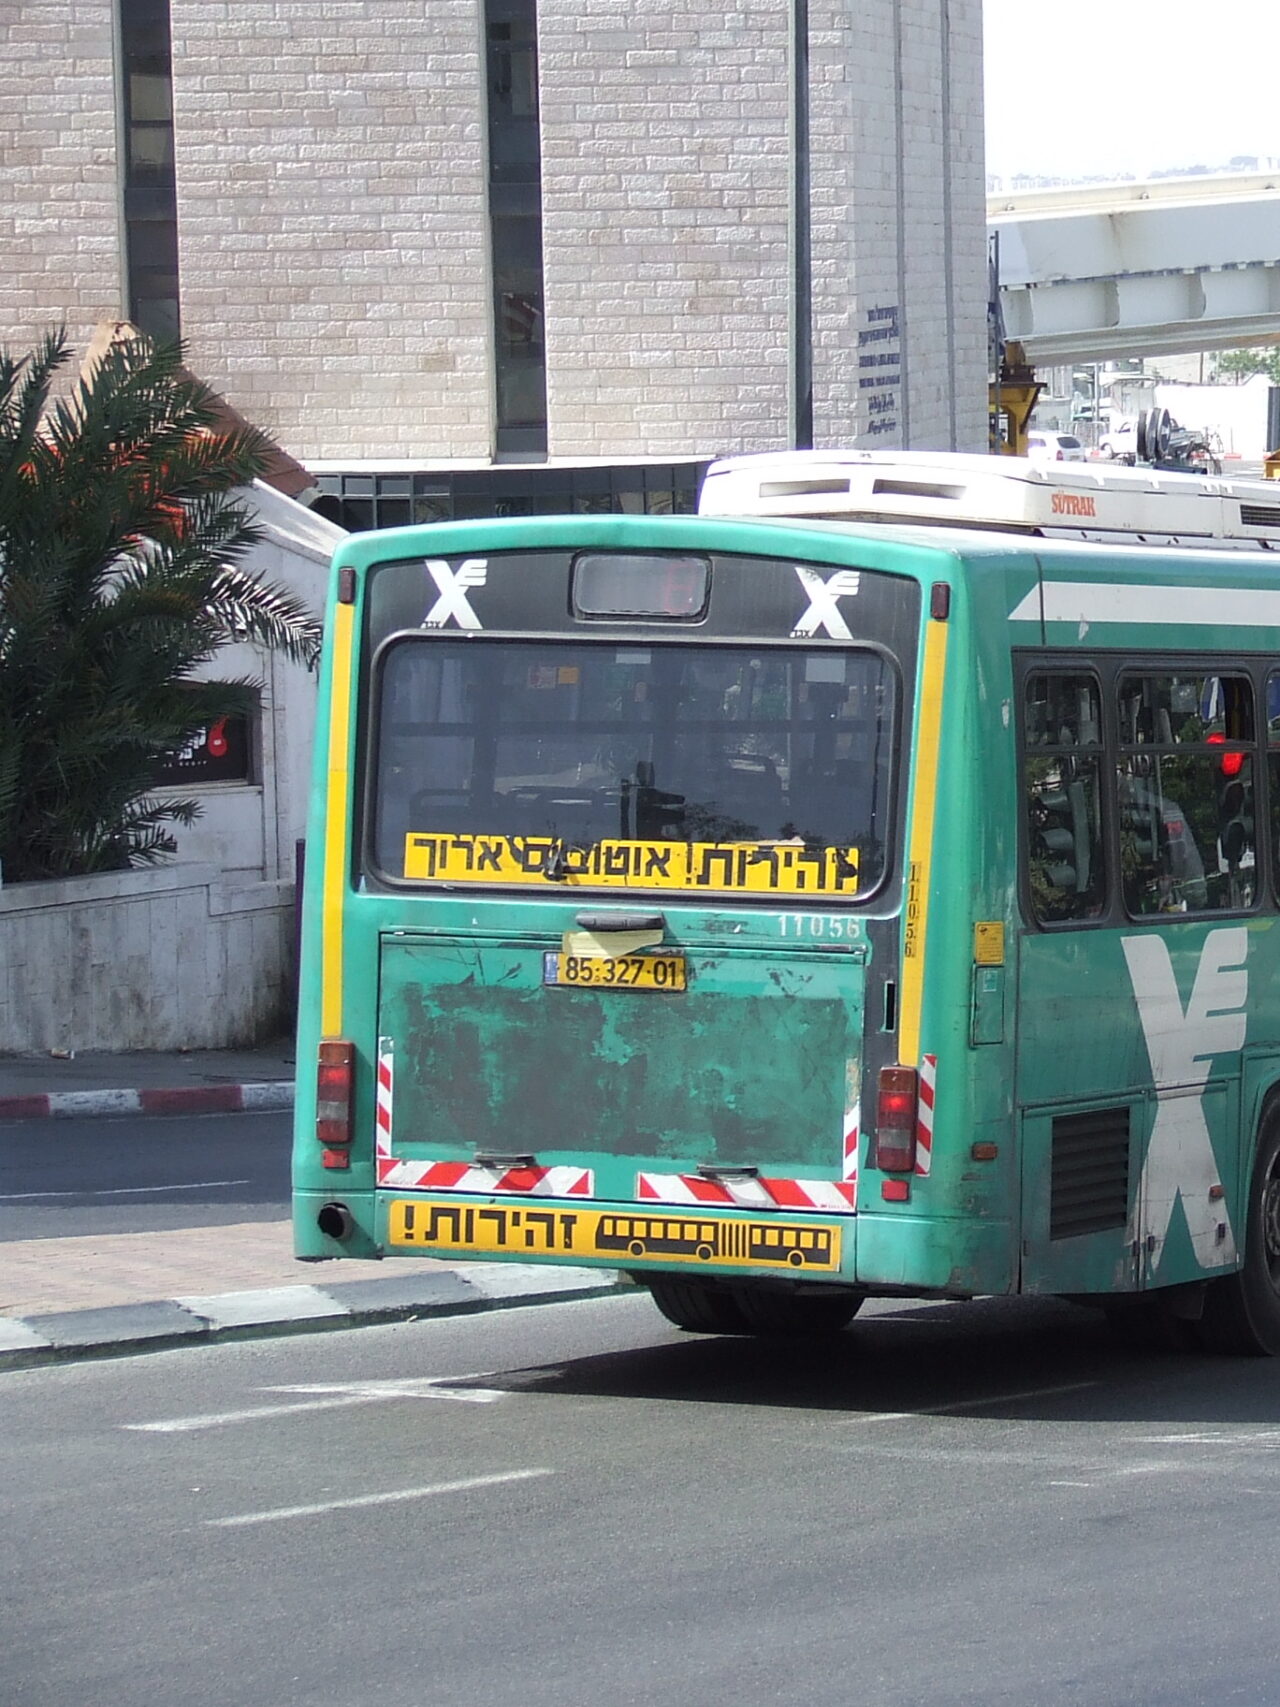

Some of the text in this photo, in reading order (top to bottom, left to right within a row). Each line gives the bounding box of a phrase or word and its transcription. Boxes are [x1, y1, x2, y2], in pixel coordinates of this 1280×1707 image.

[413, 837, 504, 878] ארוך
[777, 915, 861, 939] 11056
[404, 1204, 578, 1250] זהירות!
